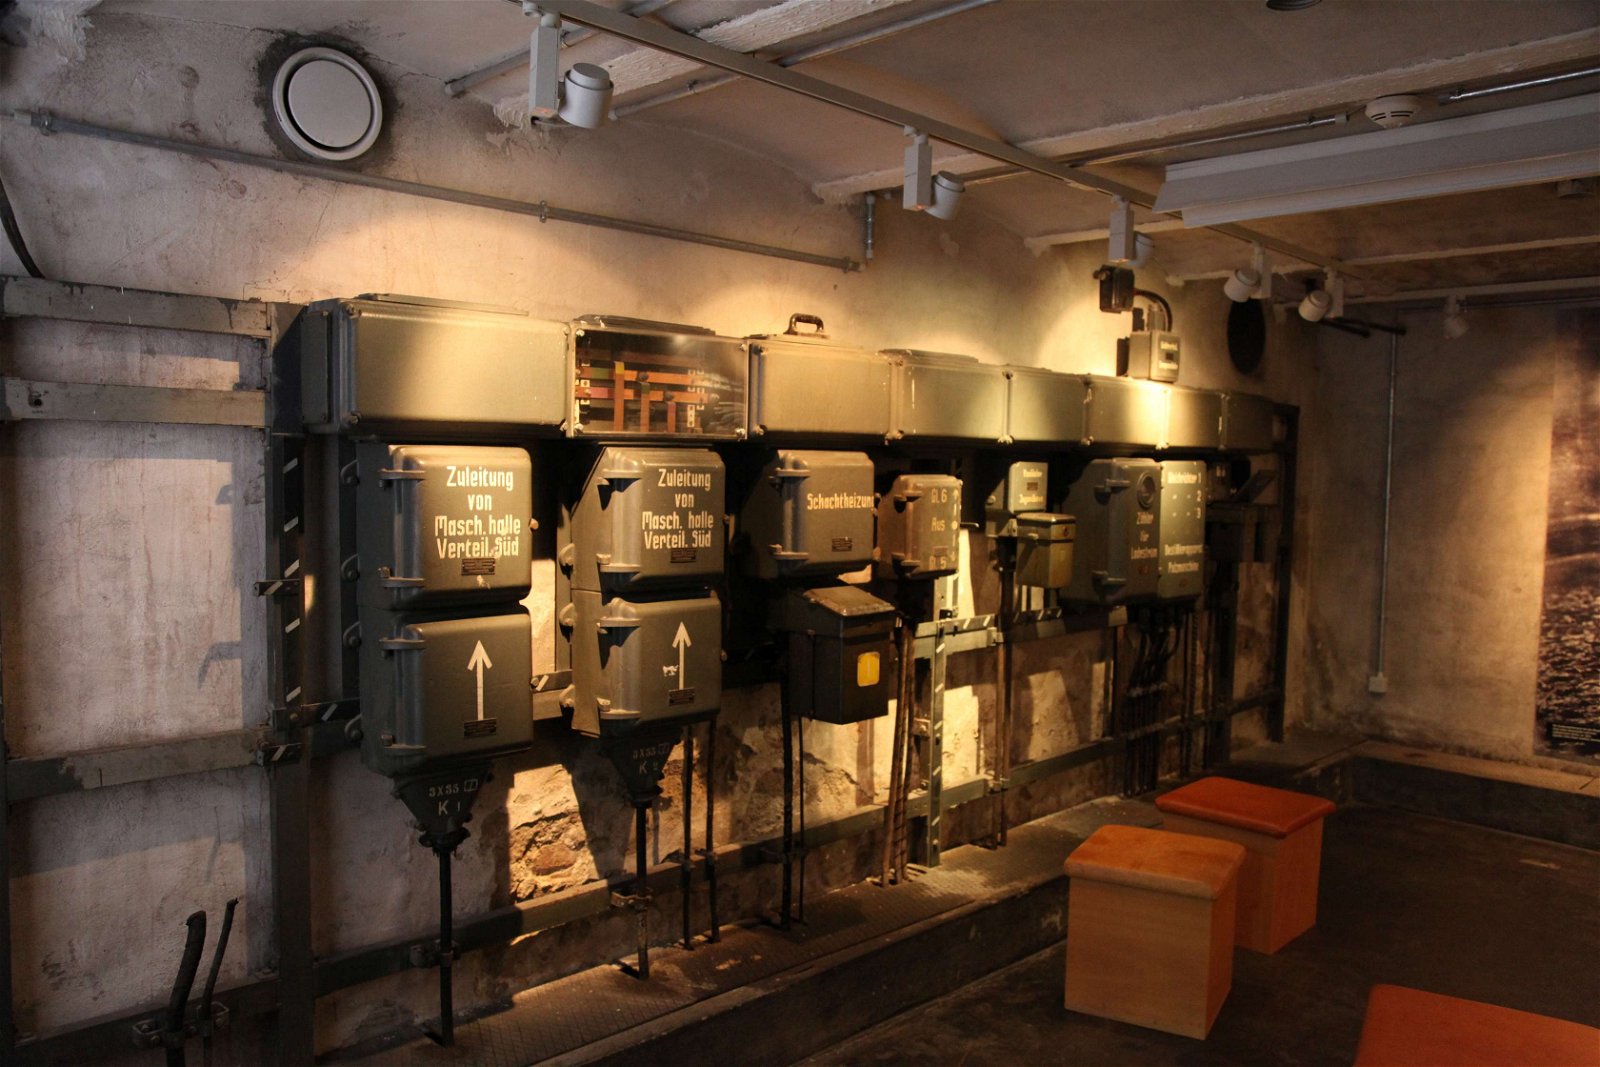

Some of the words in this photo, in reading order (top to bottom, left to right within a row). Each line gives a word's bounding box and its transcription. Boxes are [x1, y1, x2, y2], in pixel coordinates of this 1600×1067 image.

[446, 465, 514, 491] Zuleitung
[658, 468, 711, 491] Zuleitung
[467, 493, 492, 511] von
[675, 491, 694, 508] von
[435, 515, 487, 536] Masch.
[488, 513, 521, 535] halle
[642, 511, 682, 530] Masch.
[688, 510, 714, 529] halle
[931, 517, 945, 531] Aus
[494, 536, 519, 558] Süd
[644, 530, 688, 550] Verteil.
[691, 528, 711, 548] Süd
[438, 800, 449, 816] K
